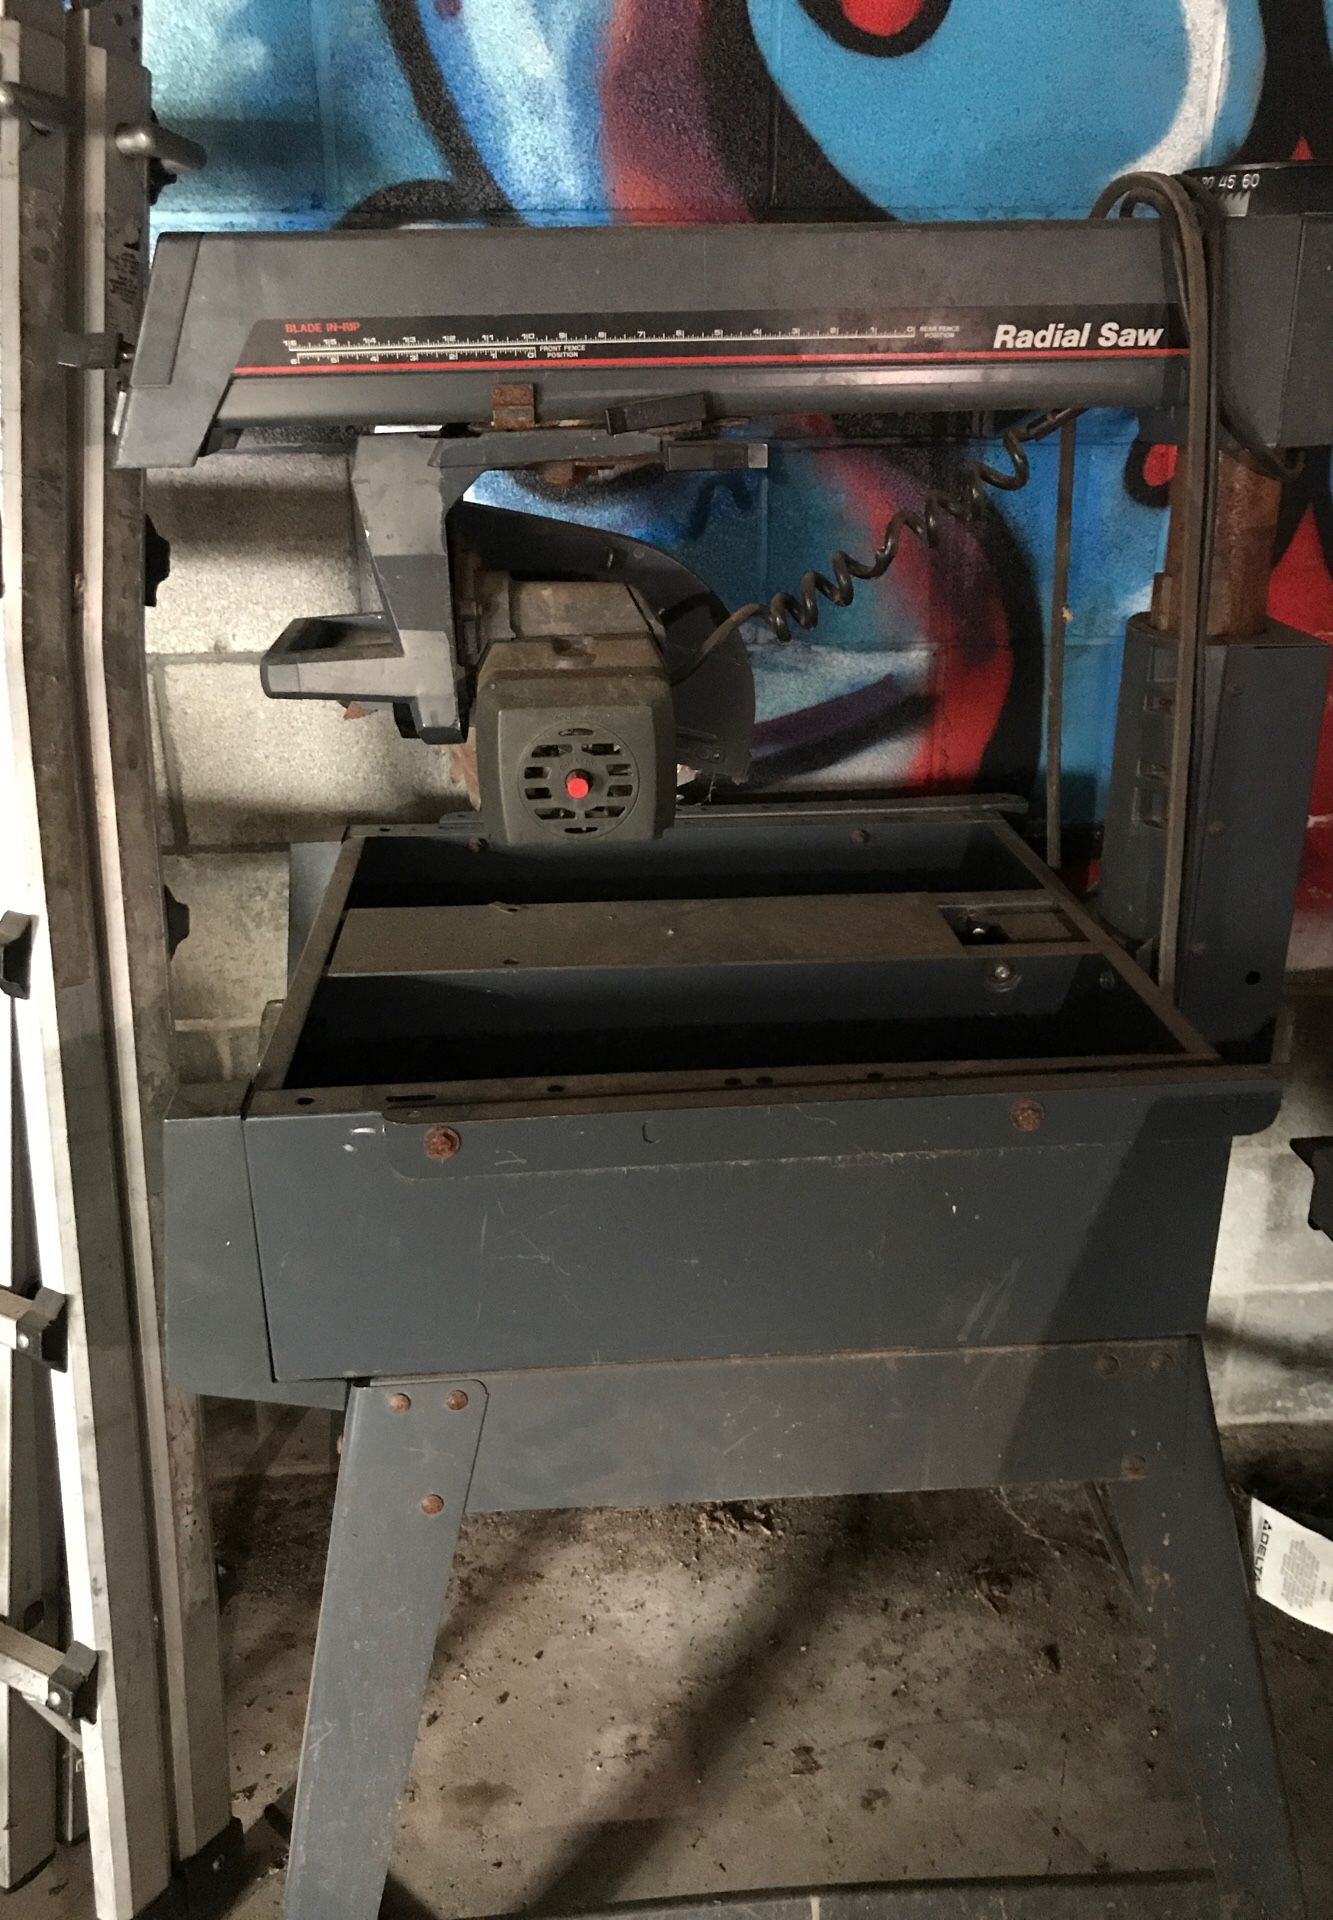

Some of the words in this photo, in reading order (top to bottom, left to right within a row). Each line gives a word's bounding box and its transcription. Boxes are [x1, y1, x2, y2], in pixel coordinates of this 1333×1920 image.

[1218, 174, 1237, 189] 45
[1242, 173, 1260, 189] 60
[284, 322, 323, 333] BLADE
[993, 322, 1092, 349] Radial
[1098, 322, 1165, 348] Saw
